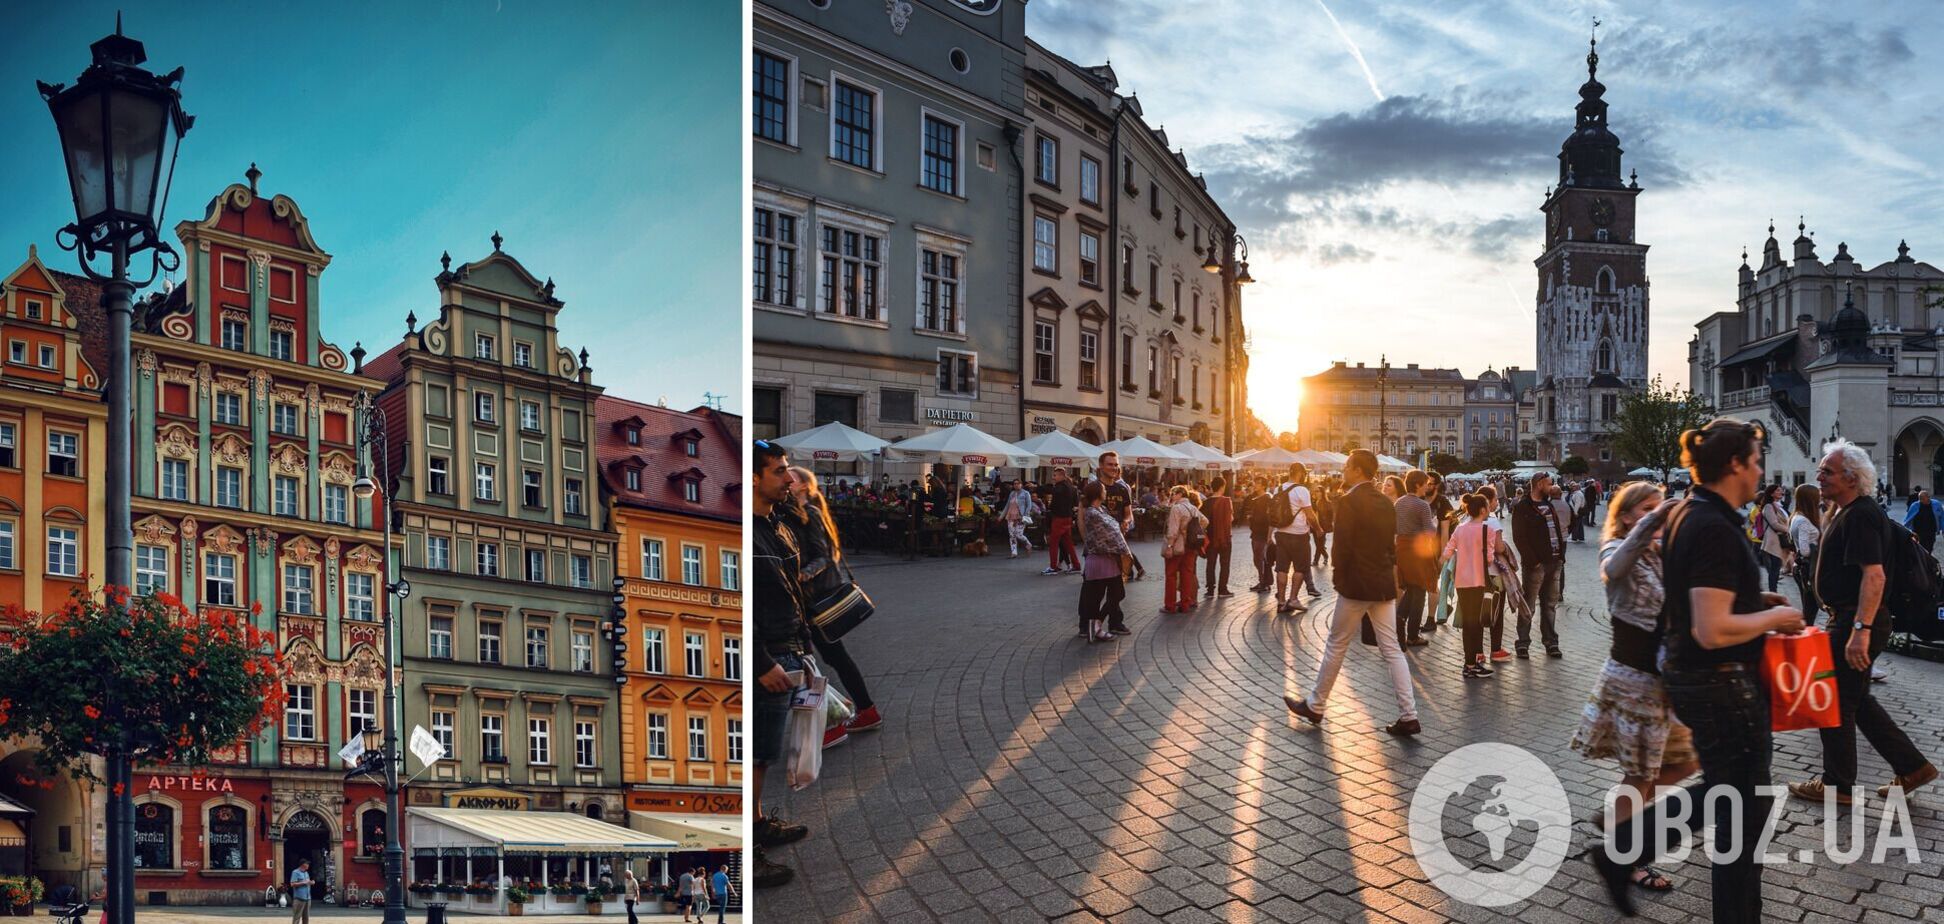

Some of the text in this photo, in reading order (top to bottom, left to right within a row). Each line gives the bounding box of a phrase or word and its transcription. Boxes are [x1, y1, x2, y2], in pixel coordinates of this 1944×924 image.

[927, 408, 974, 421] DA PIETRO
[1776, 656, 1832, 717] %
[148, 776, 233, 792] APTEKA
[457, 797, 520, 810] AKROPOLIS
